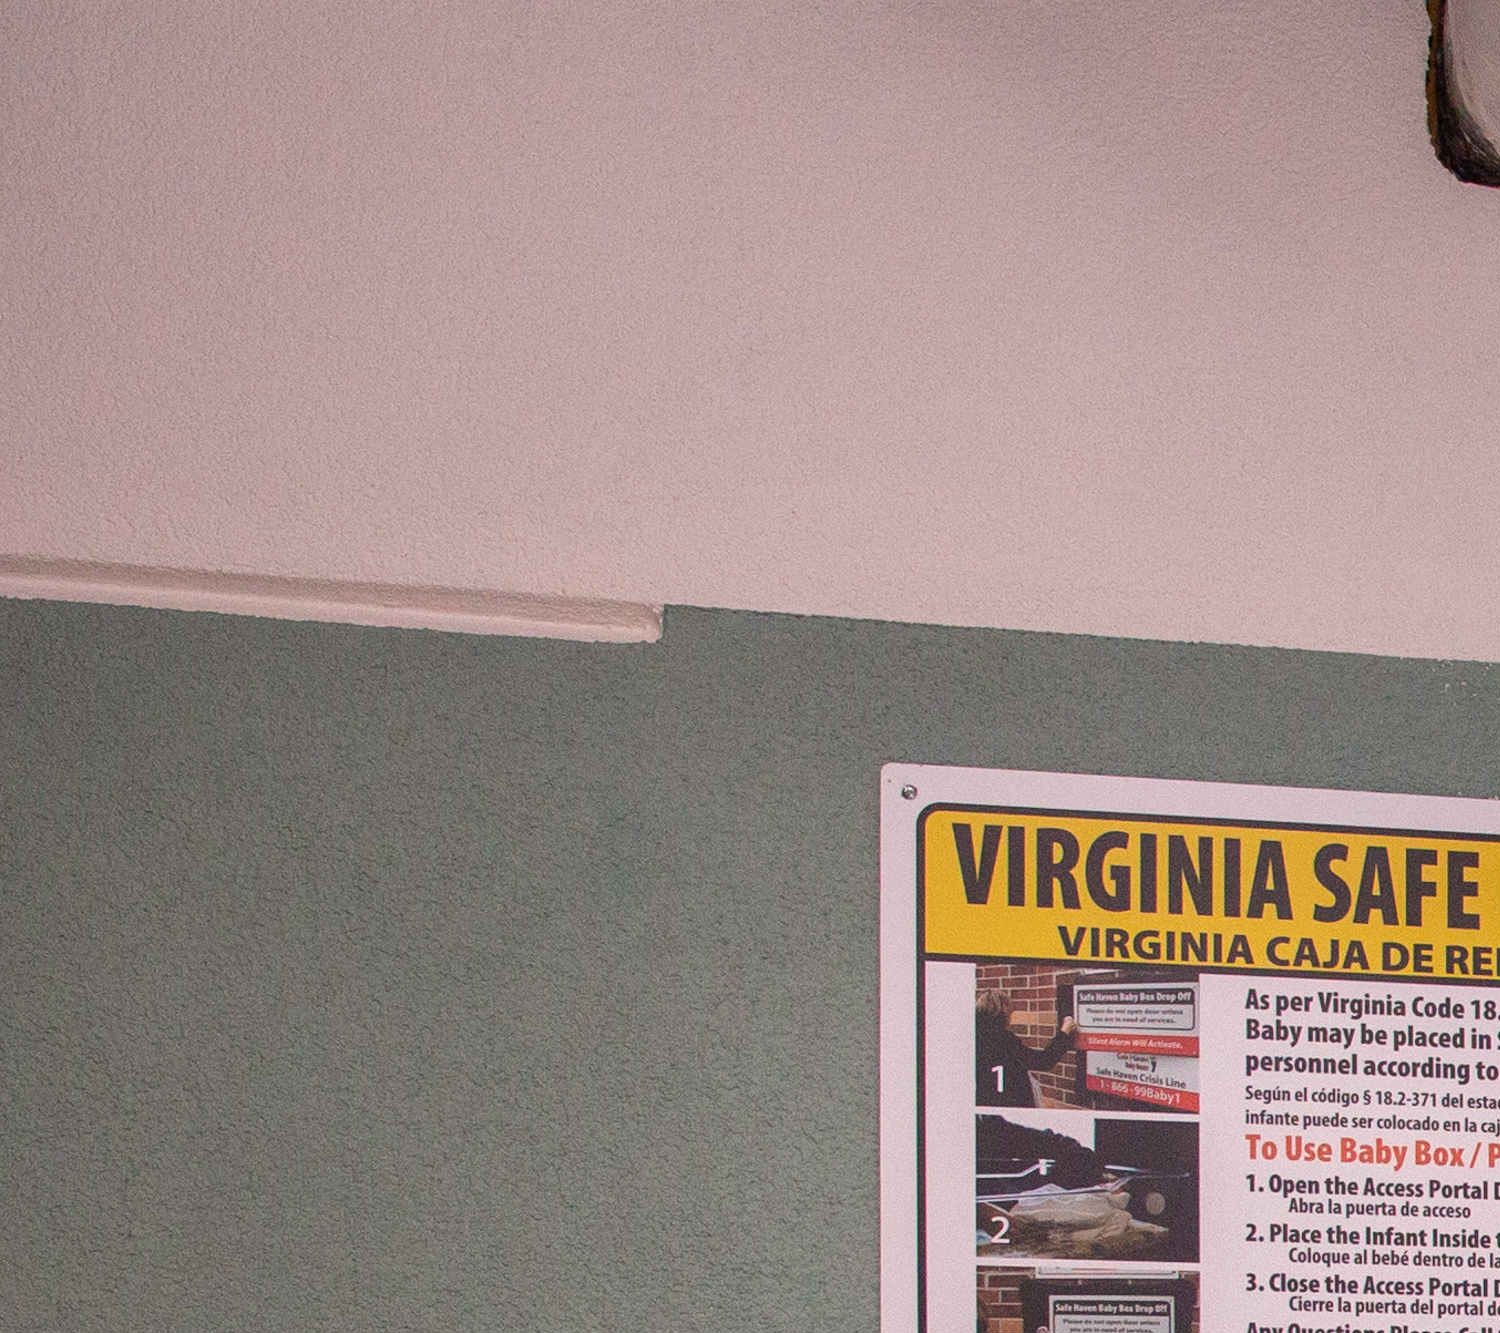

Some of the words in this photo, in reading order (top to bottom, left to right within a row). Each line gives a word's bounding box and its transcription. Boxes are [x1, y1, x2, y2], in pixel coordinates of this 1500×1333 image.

[952, 823, 1292, 919] VIRGINIA
[1313, 843, 1479, 930] SAFE
[1057, 925, 1254, 964] VIRGINIA
[1266, 936, 1369, 970] CAJA
[1382, 942, 1433, 973] DE
[1245, 989, 1270, 1010] As
[1276, 995, 1313, 1016] per
[1318, 992, 1406, 1020] Virginia
[1412, 996, 1465, 1019] Code
[991, 1066, 1005, 1092] 1
[1246, 1054, 1357, 1076] personnel
[1363, 1057, 1470, 1085] according
[1475, 1061, 1499, 1081] to
[1245, 1134, 1277, 1160] To
[1285, 1135, 1332, 1162] Use
[1341, 1137, 1407, 1172] Baby
[1415, 1140, 1464, 1167] Box
[1470, 1142, 1482, 1168] /
[1269, 1174, 1320, 1198] Open
[1324, 1176, 1359, 1195] the
[1363, 1177, 1424, 1198] Access
[1429, 1180, 1488, 1200] Portal
[990, 1216, 1010, 1244] 2
